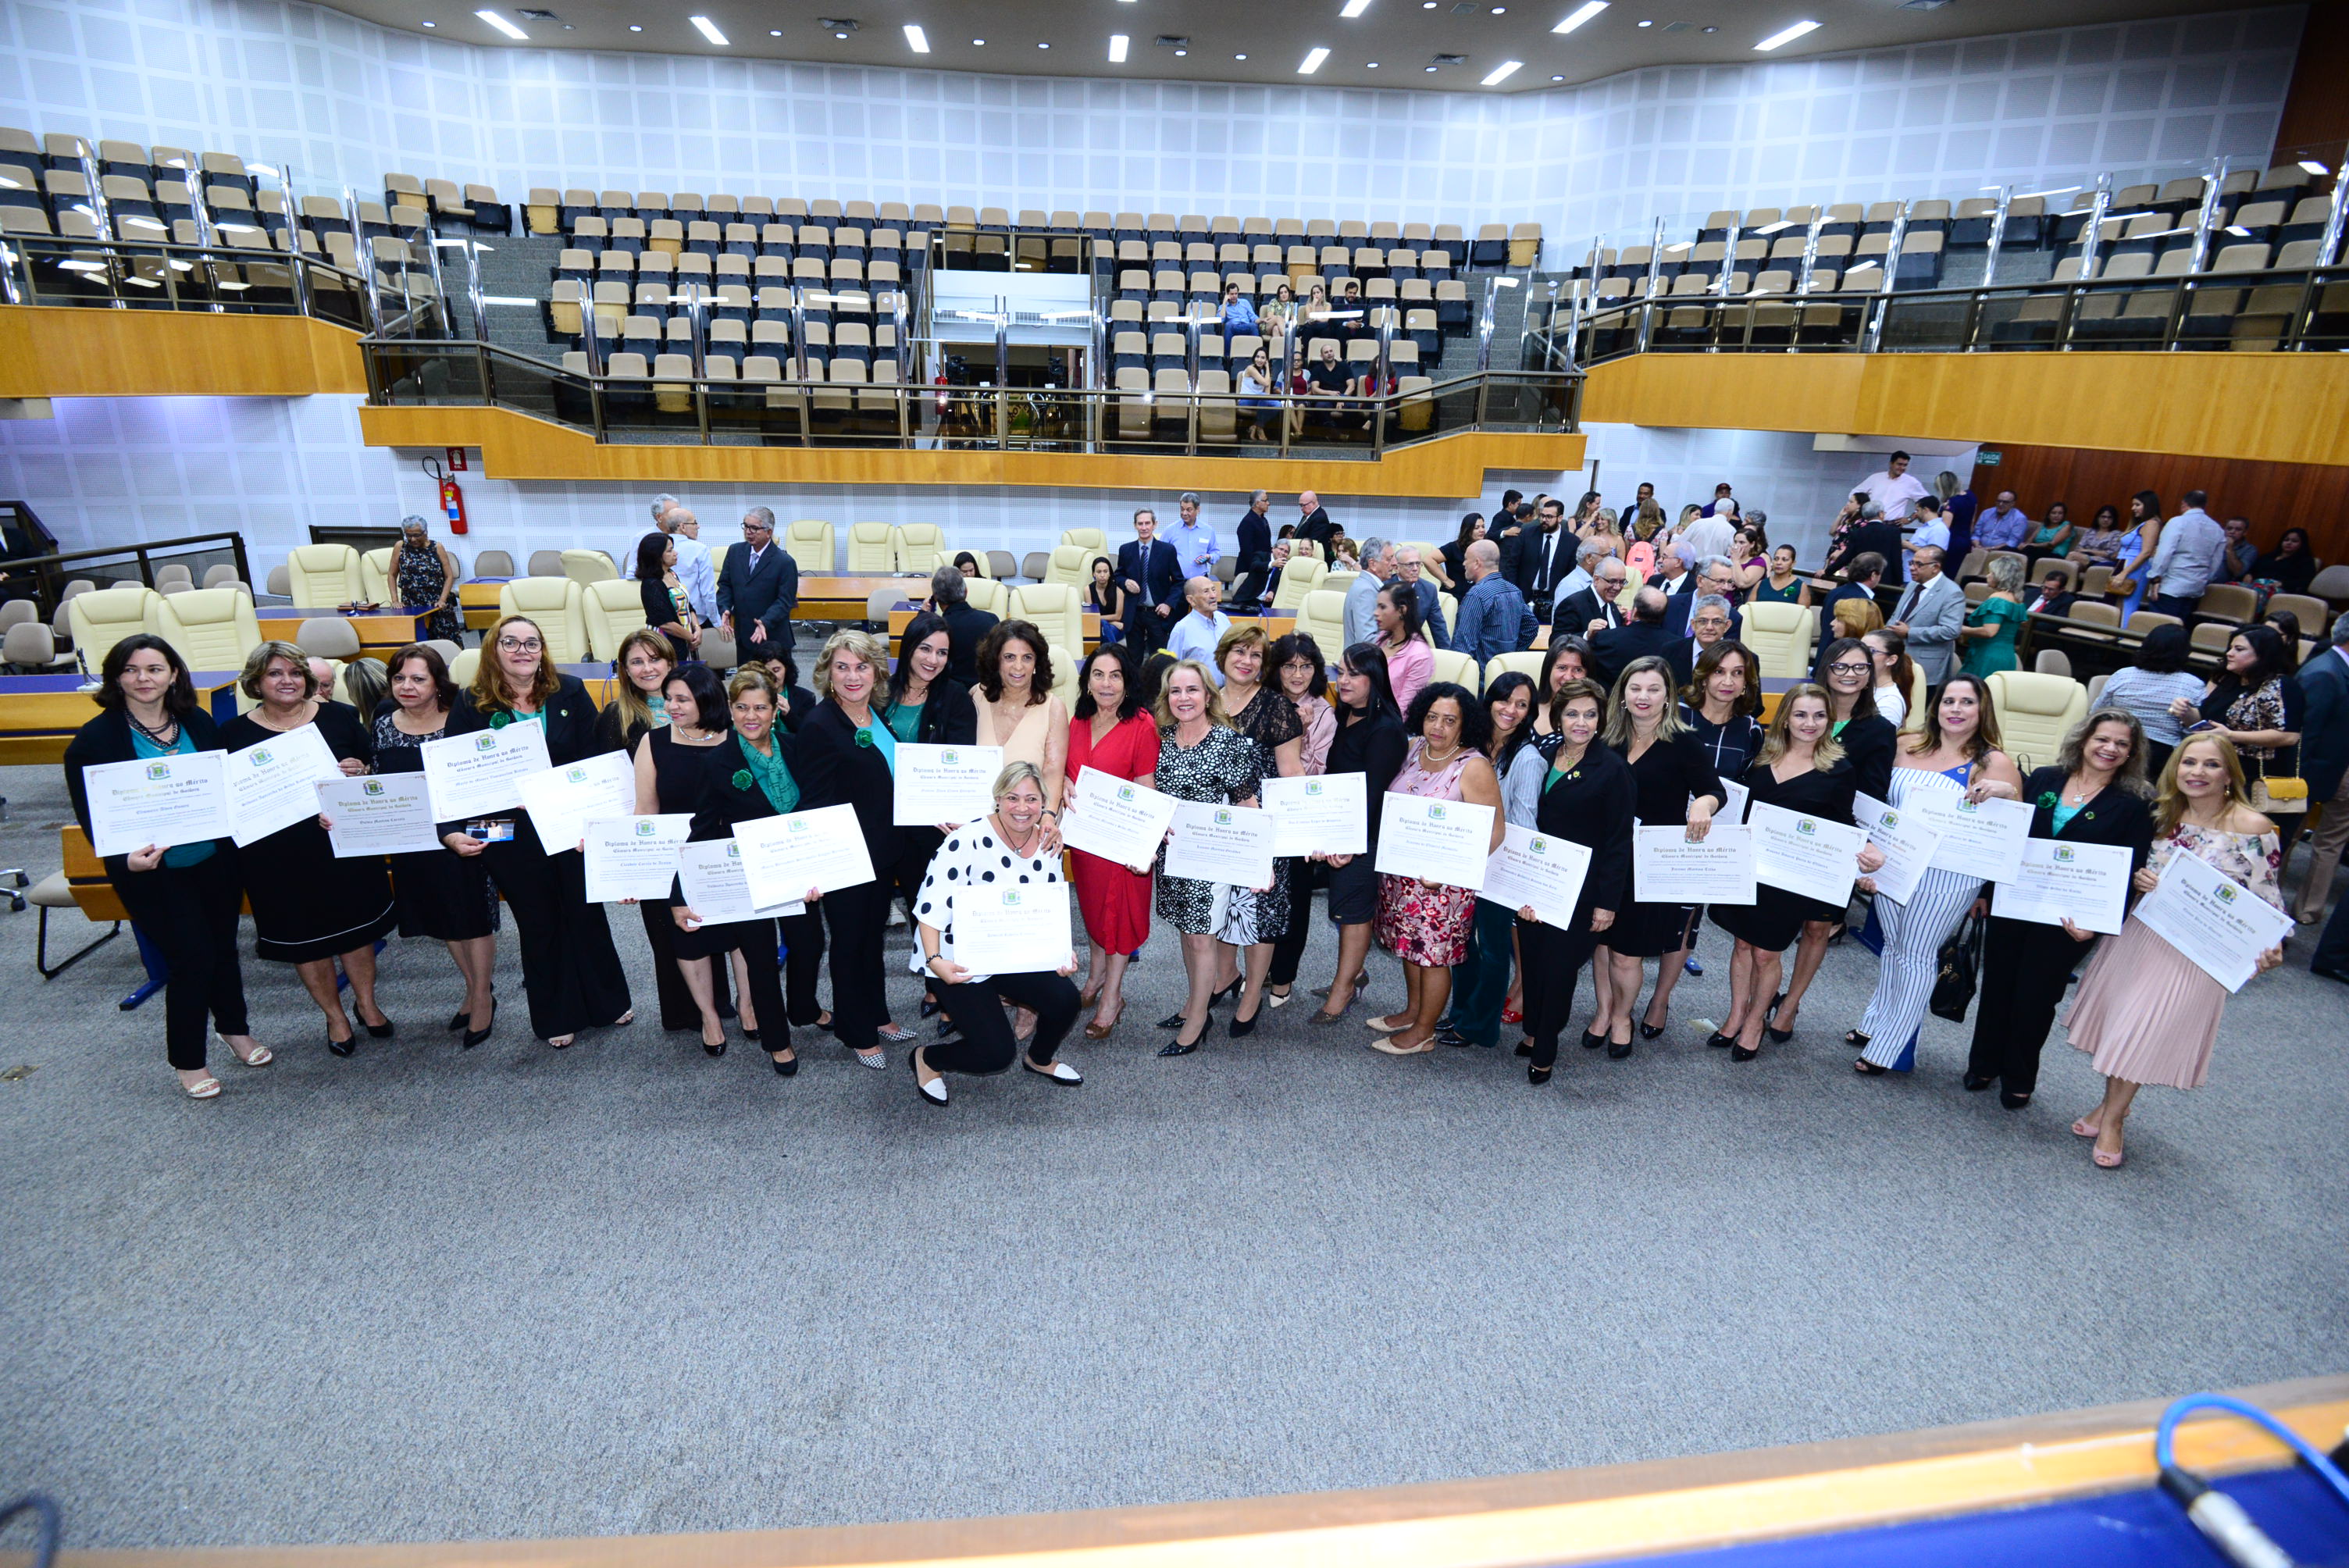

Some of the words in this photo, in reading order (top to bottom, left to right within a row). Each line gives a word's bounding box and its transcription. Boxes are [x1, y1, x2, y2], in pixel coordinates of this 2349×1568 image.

[447, 759, 472, 768] Diploma
[481, 753, 500, 761] Honra
[1089, 793, 1108, 804] Diploma
[1116, 800, 1131, 811] Honra
[1139, 809, 1154, 819] Mérito
[1186, 823, 1207, 832] Diploma
[1399, 817, 1420, 825] Diploma
[1455, 825, 1473, 834] Mérito
[1922, 808, 1945, 818] Diploma
[1957, 814, 1975, 823] Honra
[1987, 821, 2007, 829] Mérito
[1765, 827, 1787, 838] Diploma
[1796, 836, 1813, 845] Honra
[1823, 843, 1842, 853] Mérito
[1503, 846, 1521, 857] Diploma
[1529, 854, 1543, 864] Honra
[1552, 862, 1567, 872] Mérito
[2180, 878, 2201, 896] Diploma
[2202, 891, 2208, 901] de
[2209, 897, 2226, 914] Honra
[2236, 918, 2256, 935] Mérito
